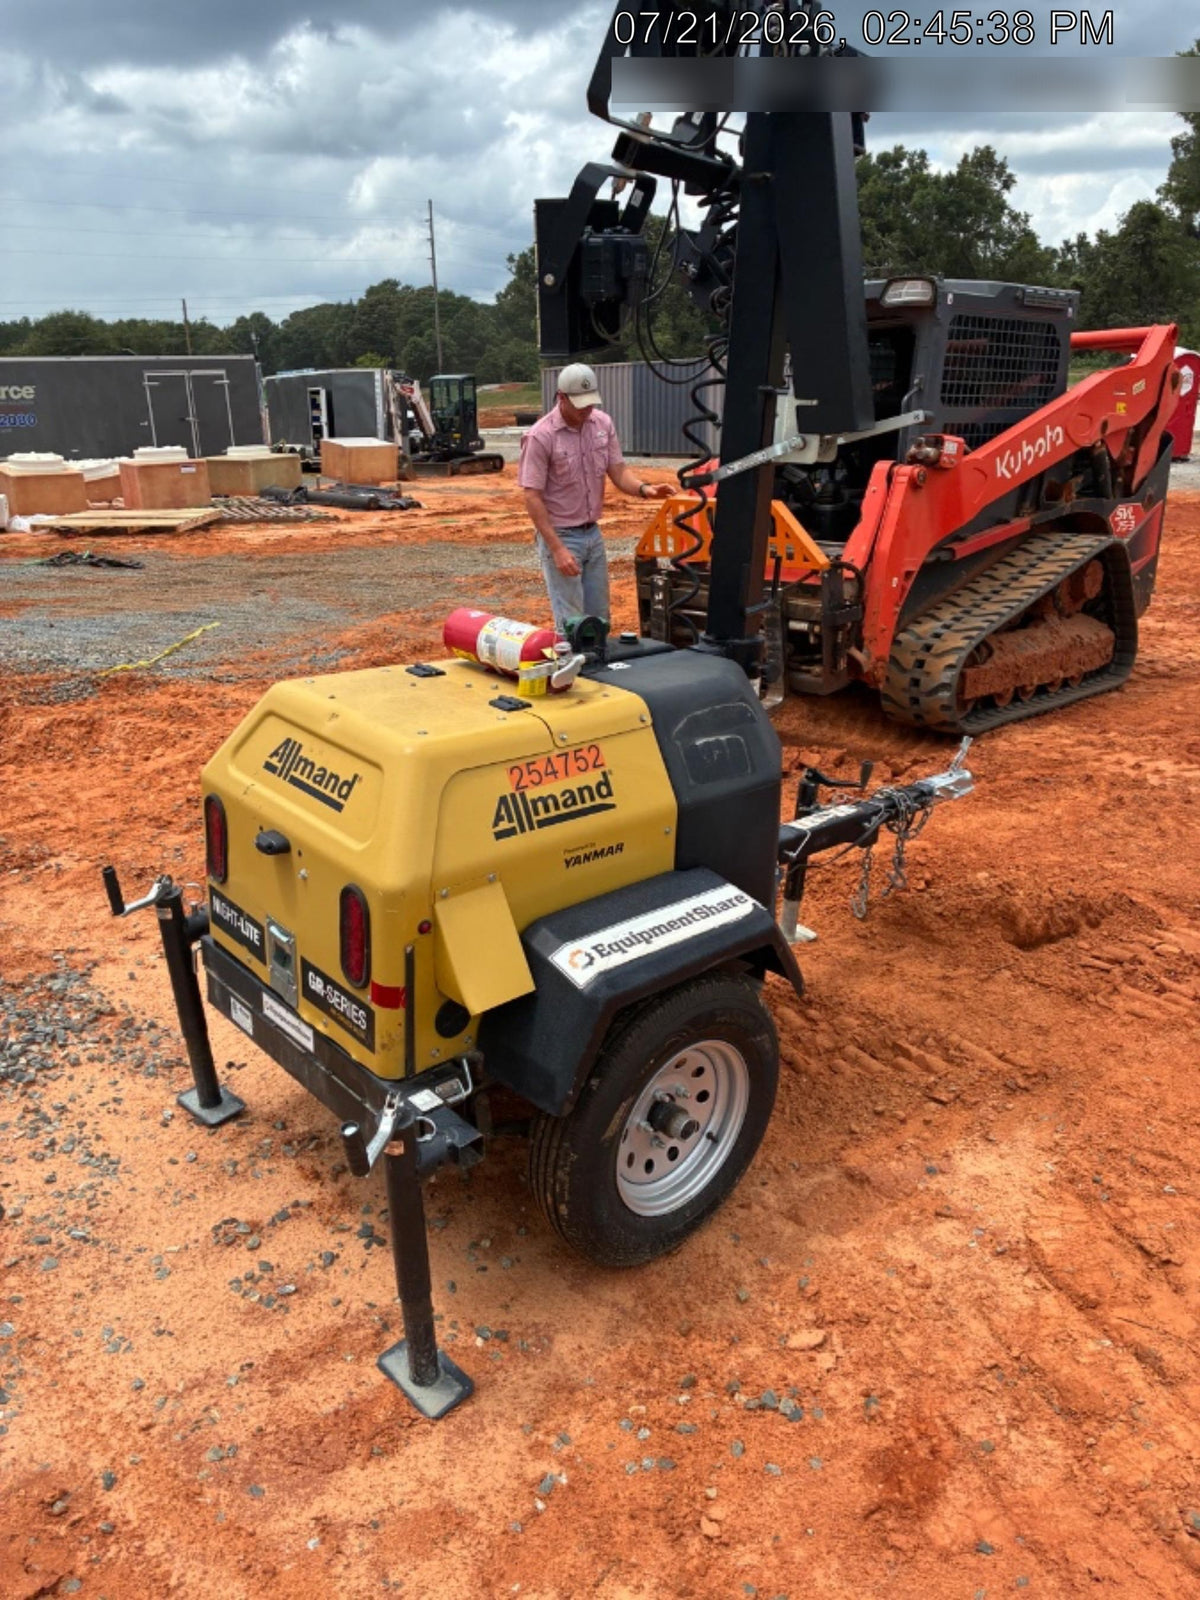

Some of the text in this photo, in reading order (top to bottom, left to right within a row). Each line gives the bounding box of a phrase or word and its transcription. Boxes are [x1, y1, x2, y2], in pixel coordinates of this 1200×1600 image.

[995, 424, 1065, 480] Kubota
[268, 737, 359, 801] Allmand
[509, 744, 606, 792] 254752
[492, 771, 615, 834] Allmand
[564, 842, 625, 869] YANMAR
[212, 895, 261, 947] NIGHT-LITE
[591, 892, 749, 960] EquipmentShare
